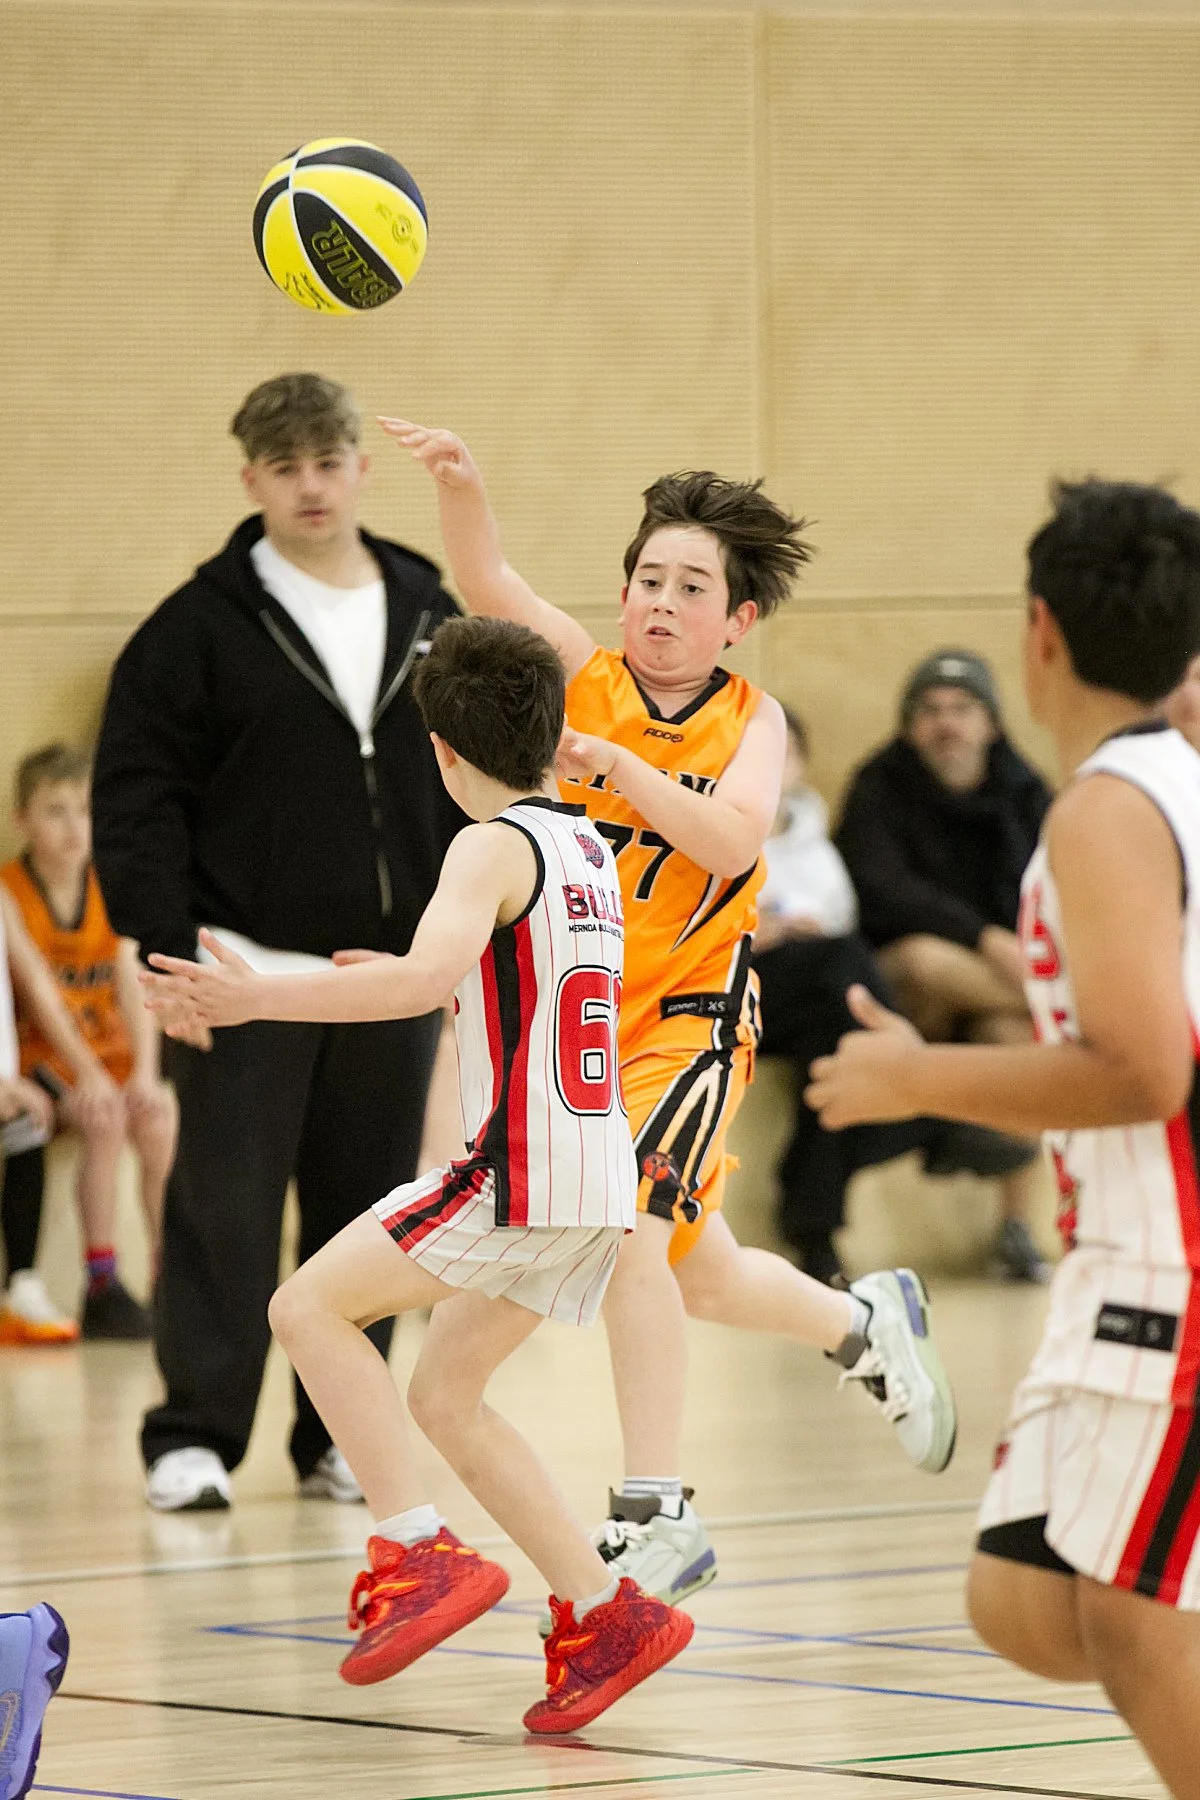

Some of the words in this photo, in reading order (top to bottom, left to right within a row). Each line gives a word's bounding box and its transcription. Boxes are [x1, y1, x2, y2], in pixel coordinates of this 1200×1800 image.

[593, 819, 676, 901] 77
[561, 883, 624, 926] BULL
[568, 923, 597, 933] MERNDA
[707, 1000, 726, 1011] XS
